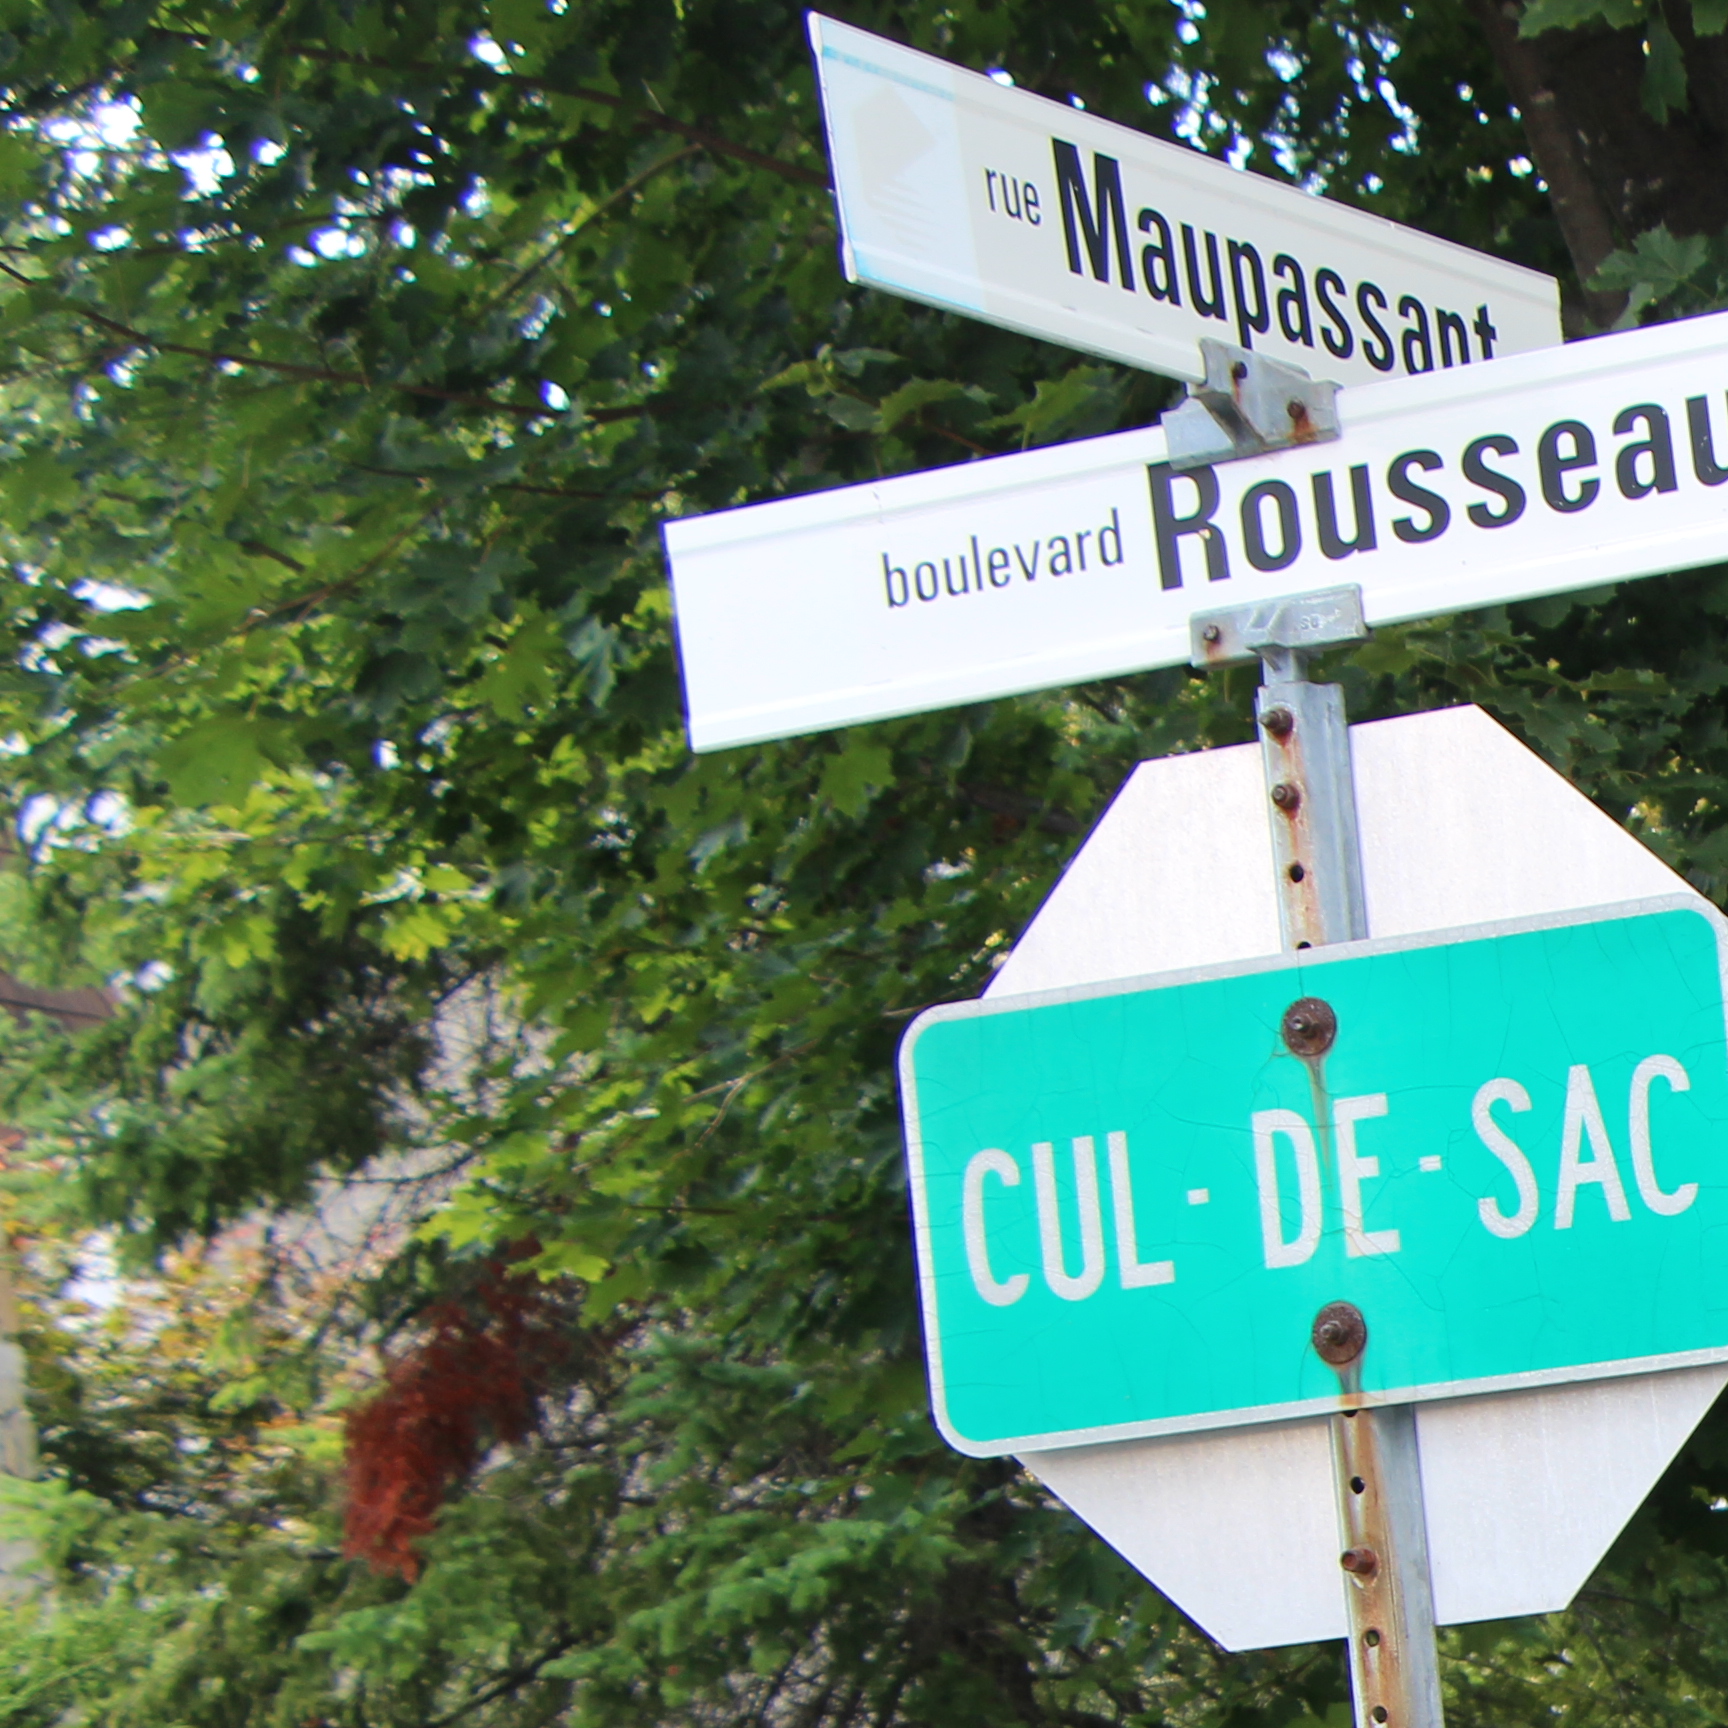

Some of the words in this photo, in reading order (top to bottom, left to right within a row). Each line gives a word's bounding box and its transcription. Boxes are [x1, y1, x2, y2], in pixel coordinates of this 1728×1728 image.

[984, 166, 1042, 227] rue
[1051, 137, 1497, 377] Maupassant
[881, 507, 1125, 608] boulevard
